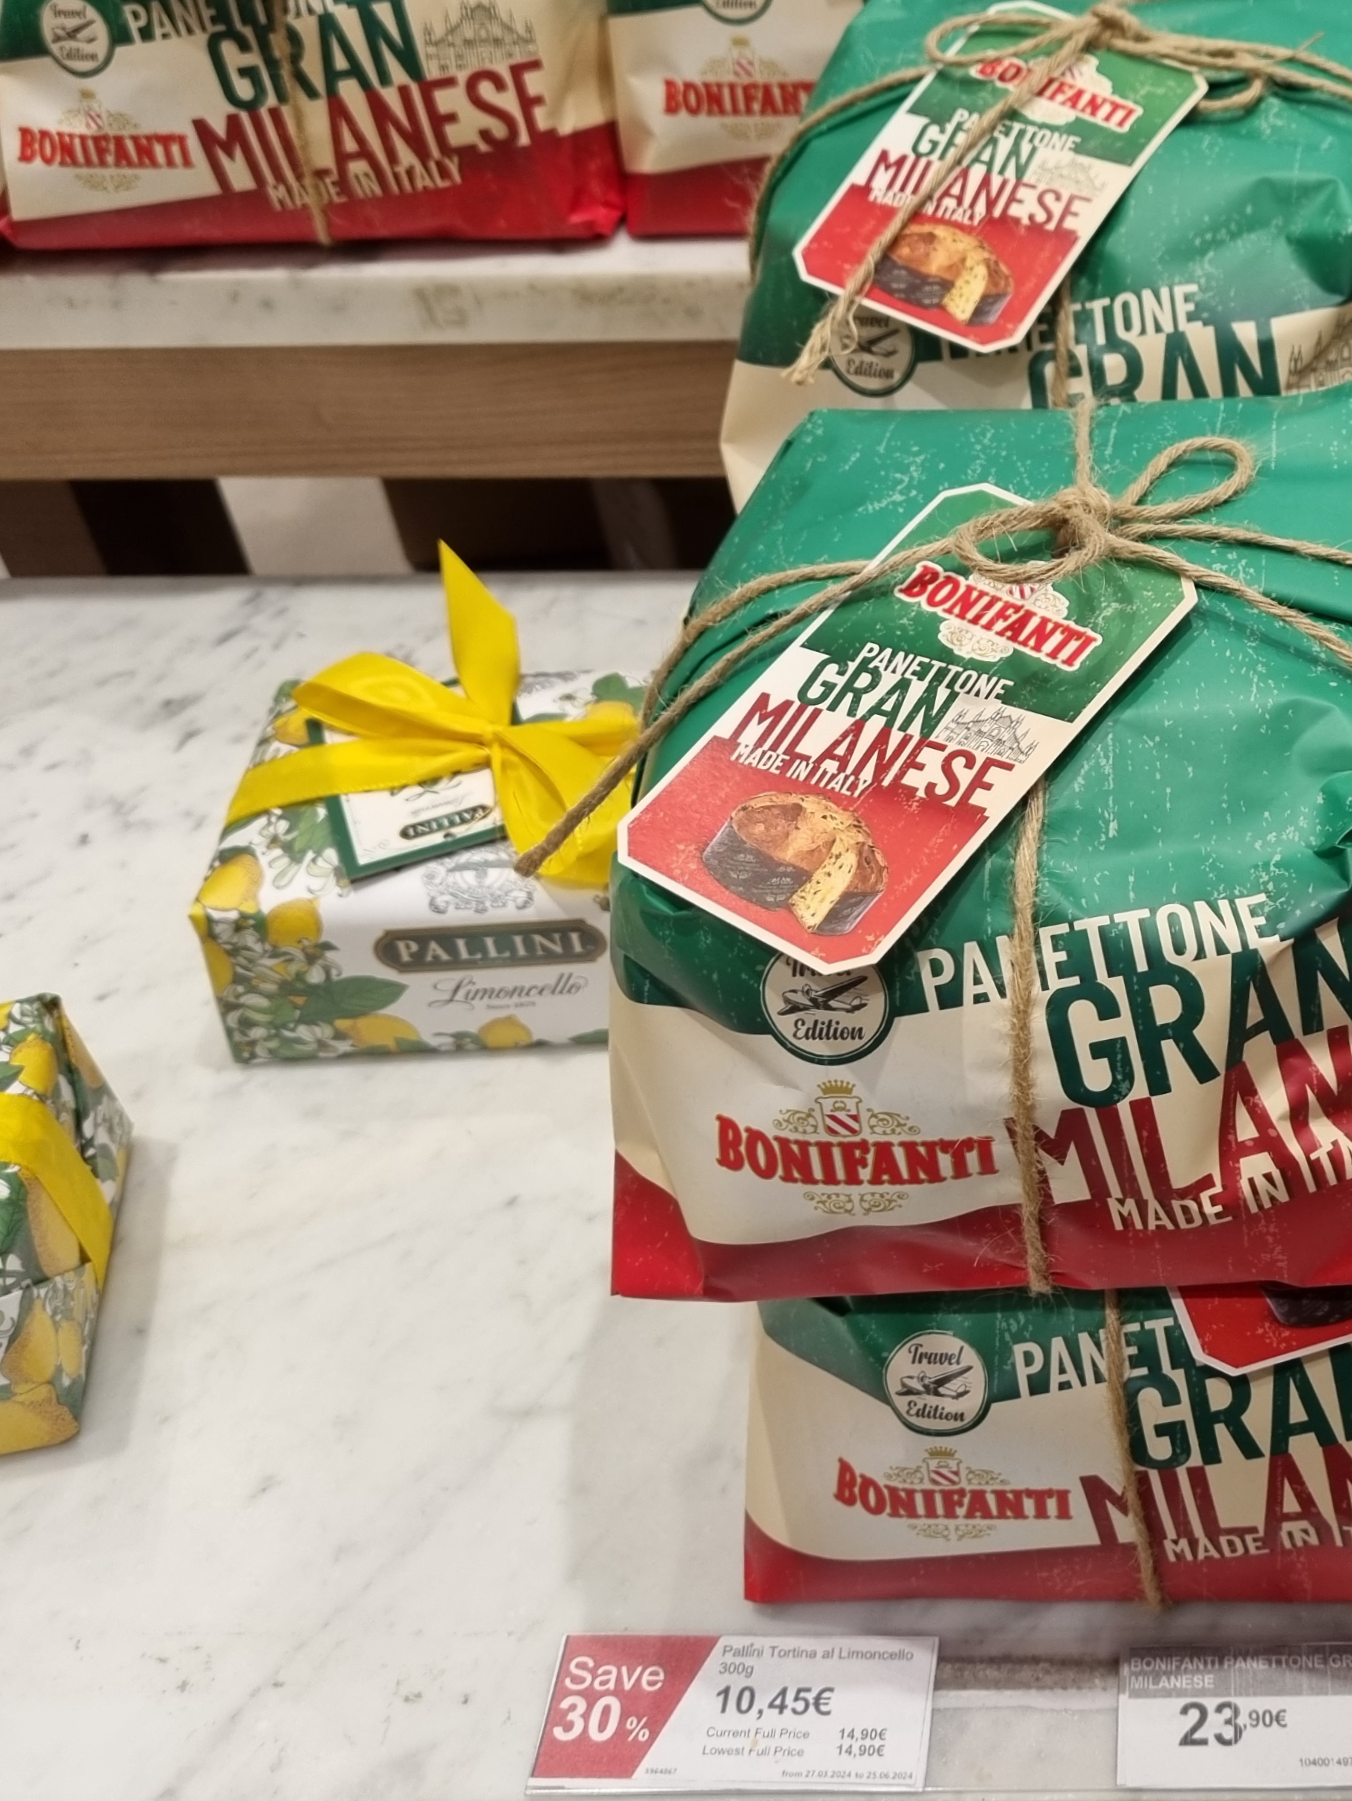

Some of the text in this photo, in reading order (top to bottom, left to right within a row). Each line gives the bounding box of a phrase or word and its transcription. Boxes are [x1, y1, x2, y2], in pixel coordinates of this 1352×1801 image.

[207, 0, 428, 112] GRAN
[664, 77, 816, 118] BONIFAN
[978, 59, 1138, 130] BOIFANTI
[192, 57, 548, 195] MILANESE
[955, 107, 1081, 152] PAETTONE
[18, 126, 195, 169] BONIFANTI
[394, 155, 463, 194] ITALY
[935, 201, 986, 226] ITALY
[848, 314, 890, 330] ravel
[846, 358, 895, 380] Edition
[901, 564, 1098, 668] BONIFANTI
[858, 642, 1015, 704] PANETTONE
[797, 654, 960, 738] GRAN
[729, 692, 1016, 808] MILANESE
[730, 743, 872, 798] MADE IN ITALY
[394, 931, 588, 963] PALLINI
[427, 971, 589, 1011] Limoncello
[792, 1017, 867, 1042] Edition
[715, 1114, 1000, 1188] BONIFANTI
[1106, 1186, 1234, 1231] MADE
[1242, 1166, 1291, 1215] IN
[907, 1341, 966, 1370] Travel
[1013, 1317, 1195, 1399] PANET
[904, 1397, 966, 1424] Edition
[832, 1456, 1072, 1522] BONIFANTI
[1163, 1533, 1271, 1563] MADE
[1280, 1523, 1321, 1550] IN
[718, 1662, 755, 1679] 300g
[722, 1643, 914, 1661] Pallini Tortina al Limoncello
[1130, 1656, 1219, 1672] BONIFANTI
[1223, 1654, 1325, 1670] PANETTONE
[564, 1656, 666, 1691] Save
[1130, 1674, 1215, 1689] MILANESE
[715, 1684, 836, 1720] 10,45€
[702, 1744, 805, 1758] Lowest Full Price
[706, 1726, 810, 1740] Current Full Price
[836, 1744, 886, 1759] 14,90€
[838, 1727, 888, 1743] 14,90€
